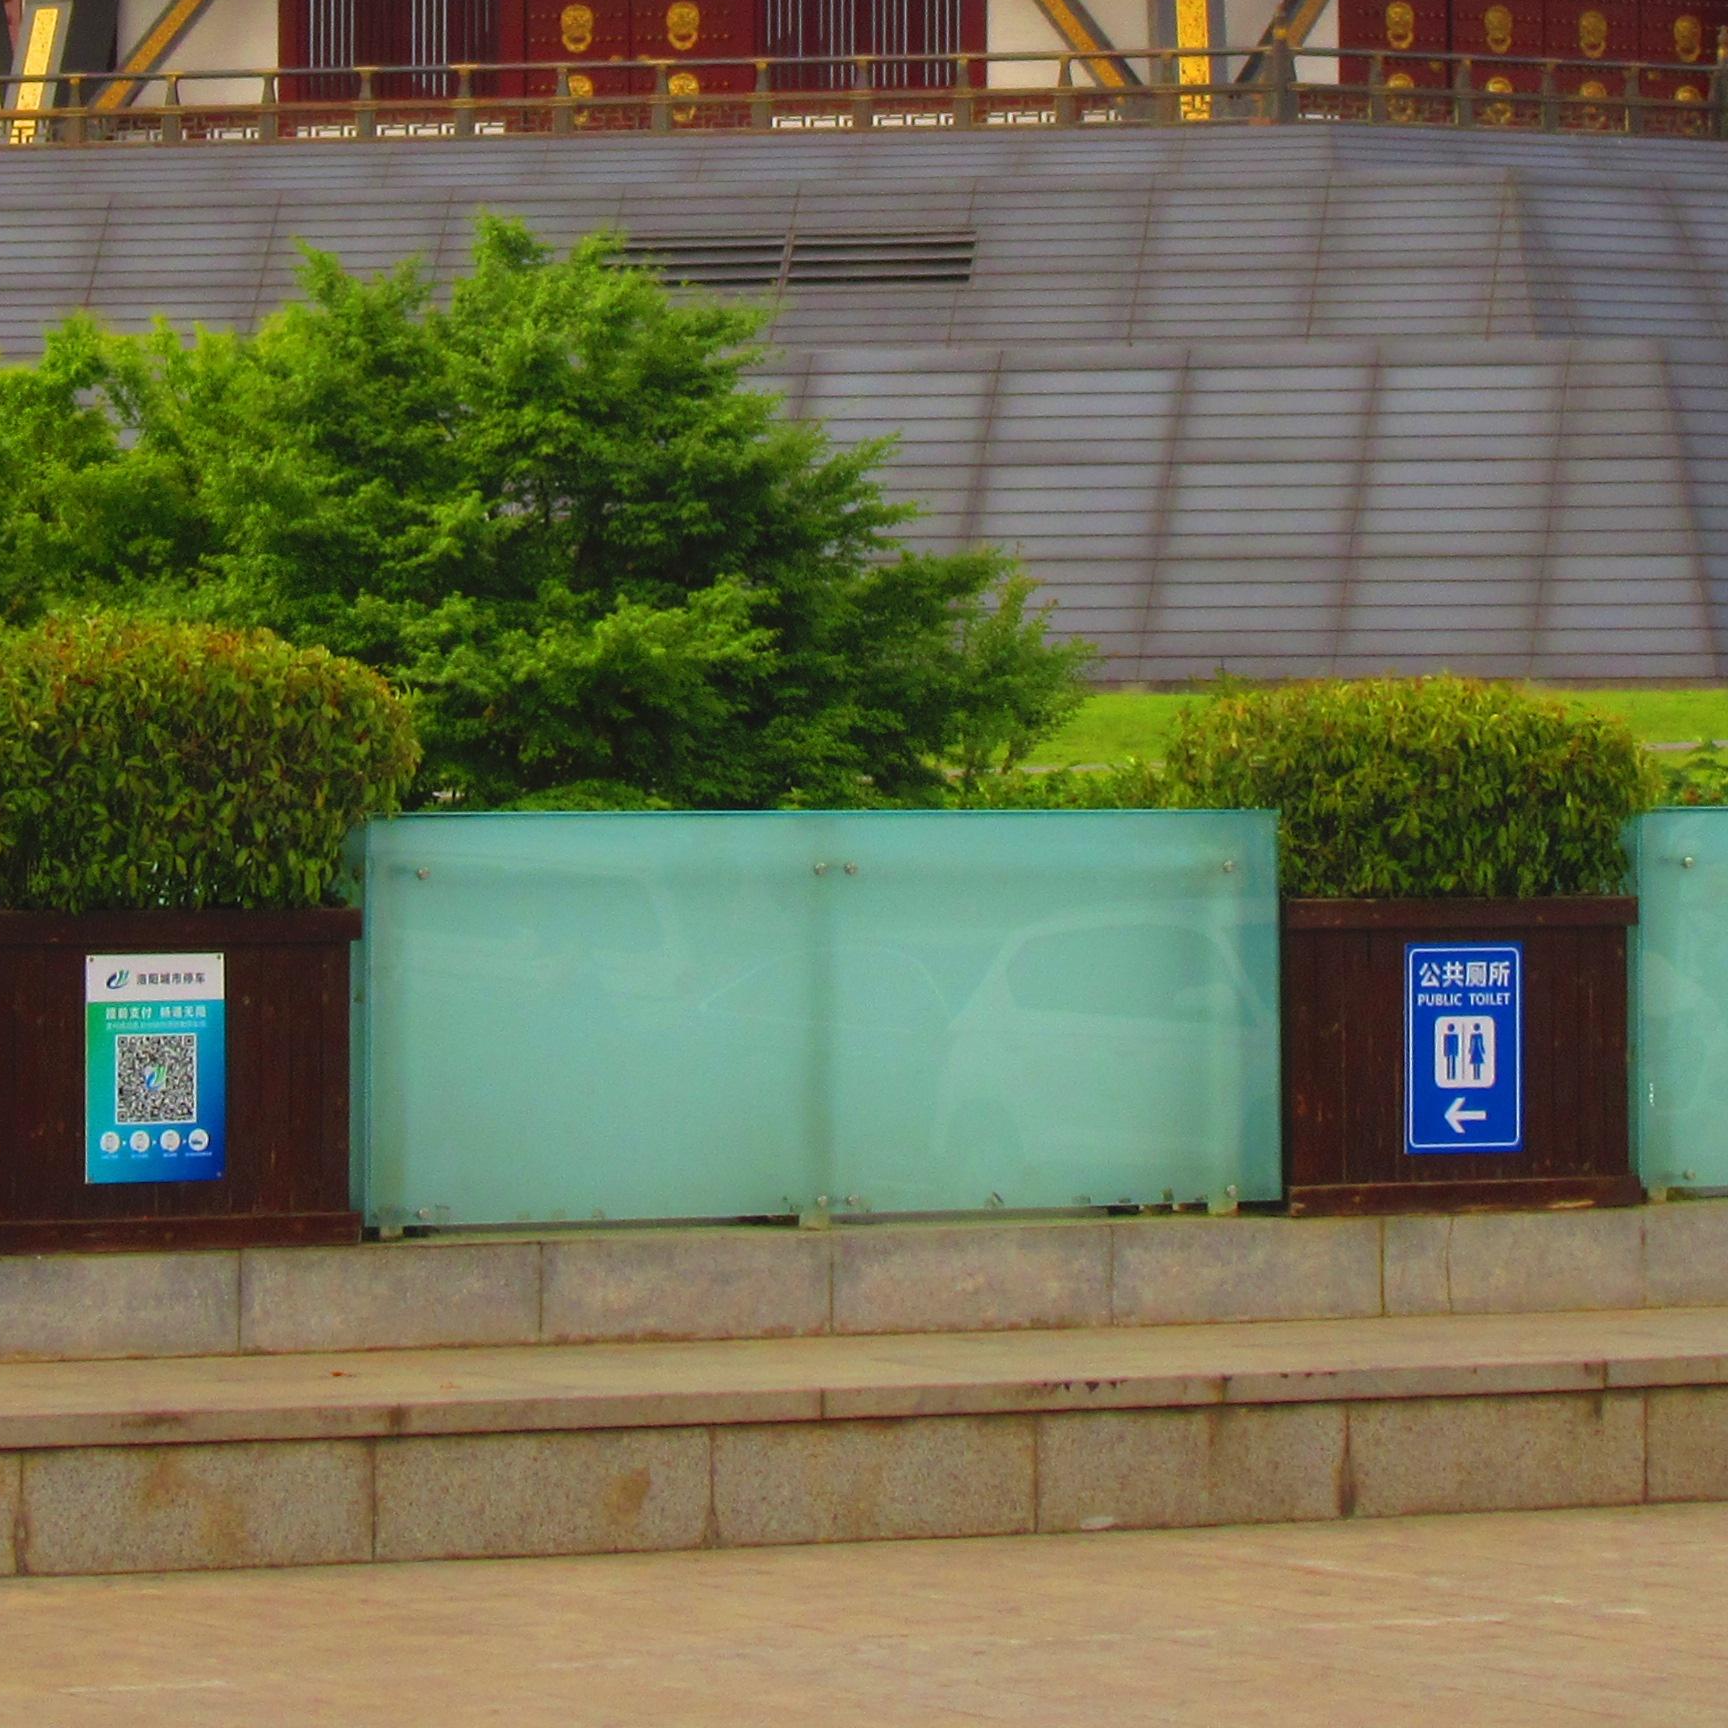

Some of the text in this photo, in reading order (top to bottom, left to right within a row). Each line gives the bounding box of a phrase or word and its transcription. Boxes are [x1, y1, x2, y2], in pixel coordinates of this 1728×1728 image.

[1419, 960, 1511, 988] 公共厕所
[1417, 991, 1511, 1007] PUBLIC TOILET
